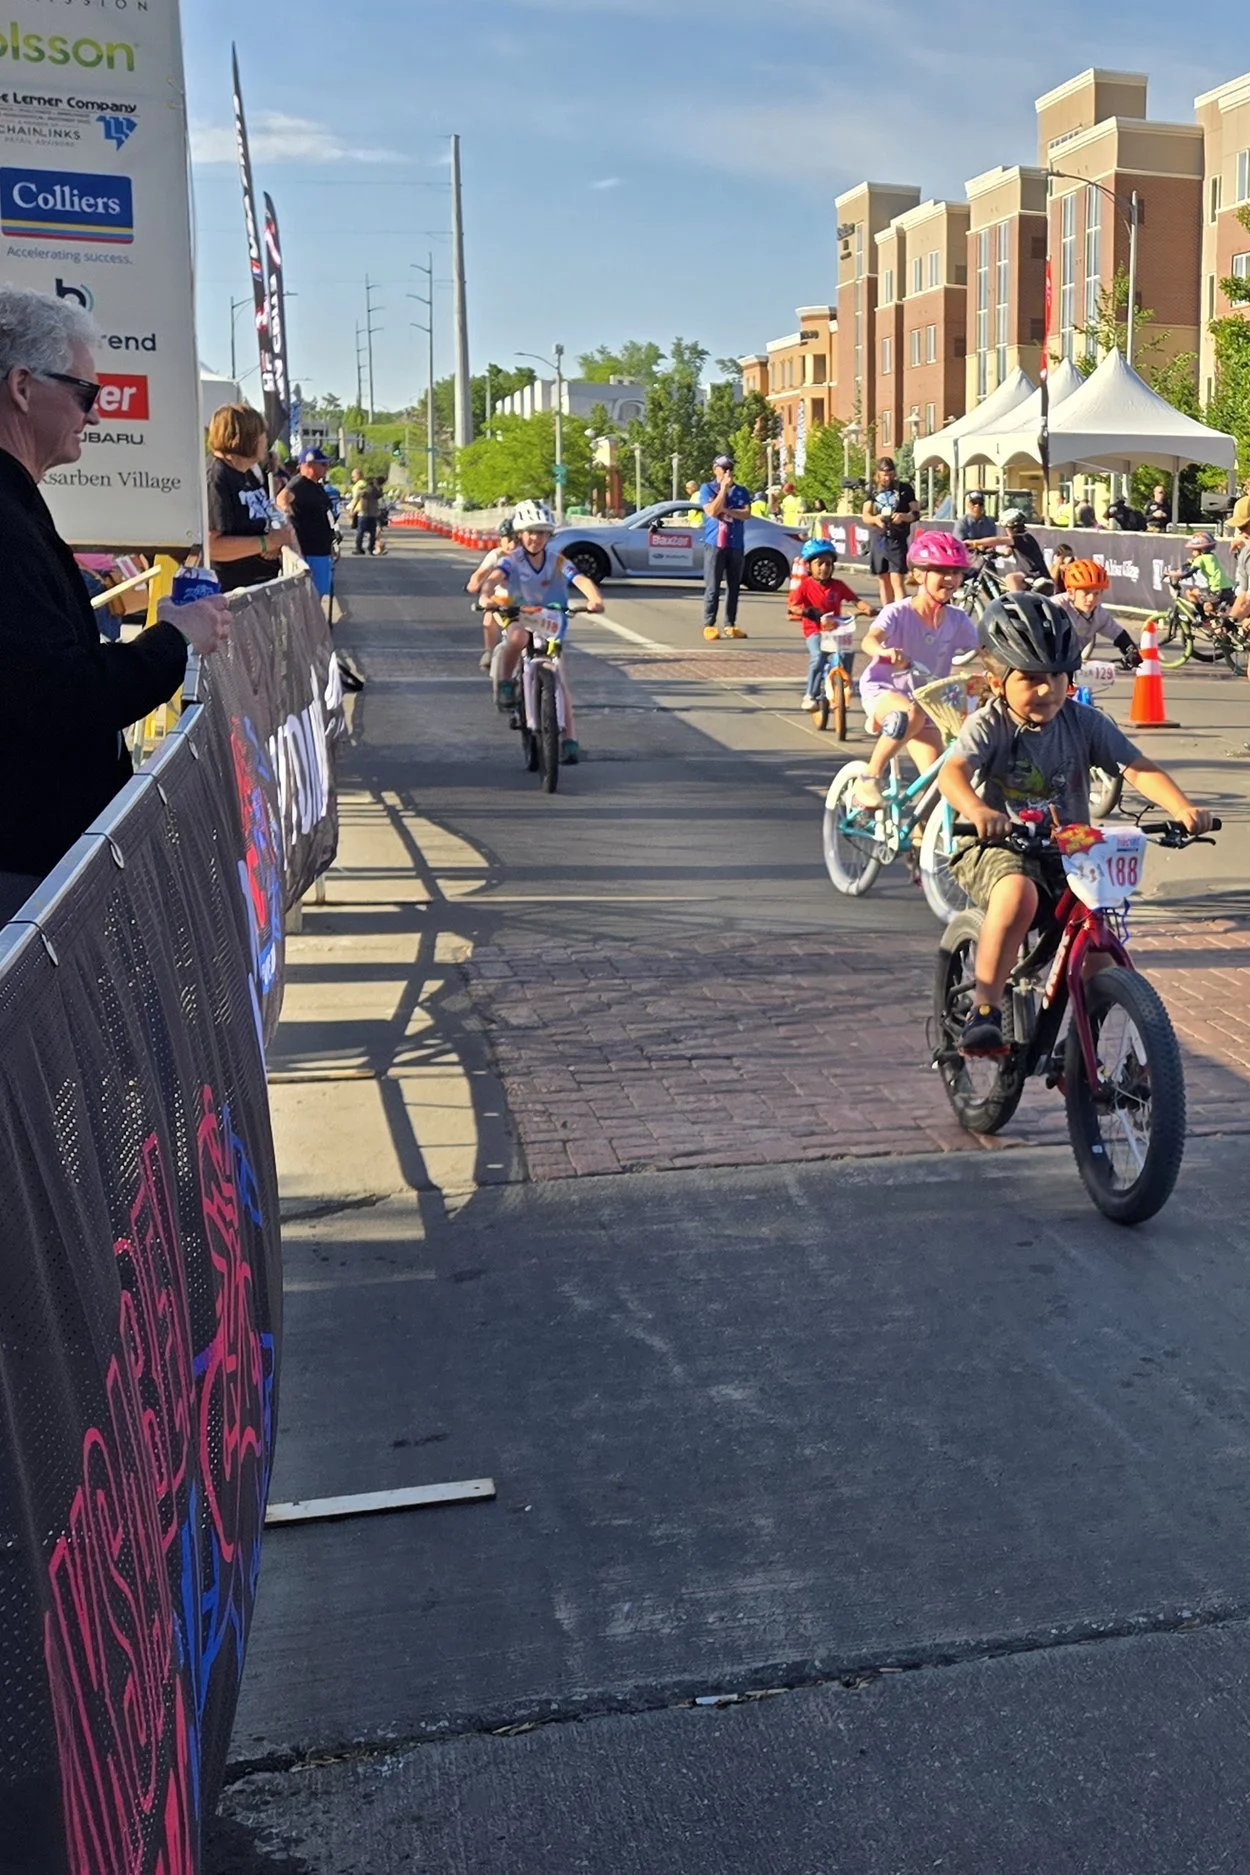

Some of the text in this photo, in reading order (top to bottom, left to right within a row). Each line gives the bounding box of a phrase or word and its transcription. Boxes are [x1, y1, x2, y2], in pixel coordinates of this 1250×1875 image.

[12, 92, 63, 108] Lerner
[67, 96, 137, 114] Company
[12, 182, 121, 215] Colliers
[7, 245, 133, 265] Accelerating success.
[80, 431, 144, 446] UBARU
[117, 471, 182, 493] Village
[1107, 856, 1138, 887] 188
